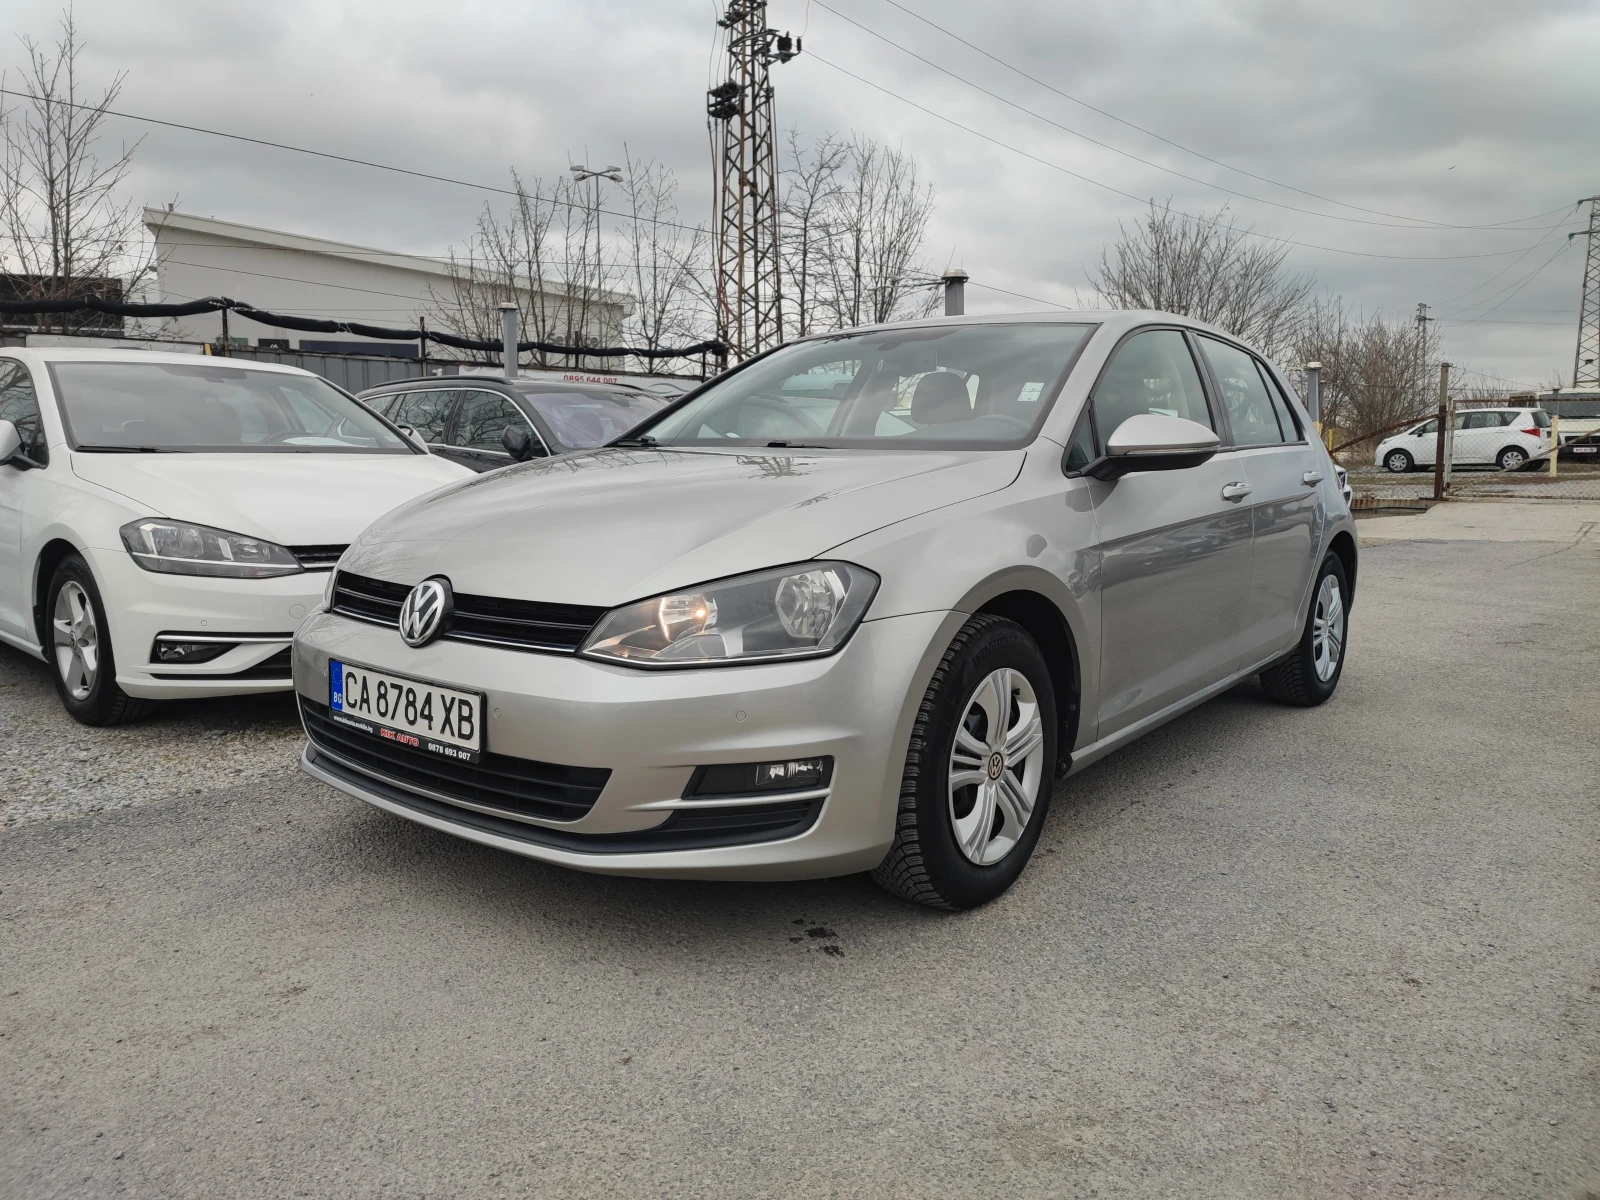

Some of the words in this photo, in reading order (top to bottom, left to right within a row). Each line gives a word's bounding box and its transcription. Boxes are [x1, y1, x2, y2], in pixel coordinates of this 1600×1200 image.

[548, 332, 599, 347] Sece
[333, 691, 343, 704] BG
[345, 671, 371, 714] CA
[376, 680, 434, 731] 8784
[440, 694, 475, 741] XB
[380, 727, 396, 741] KIK
[396, 733, 420, 747] AUTO
[428, 742, 444, 754] 0878
[444, 747, 457, 757] 693
[458, 751, 471, 761] 007
